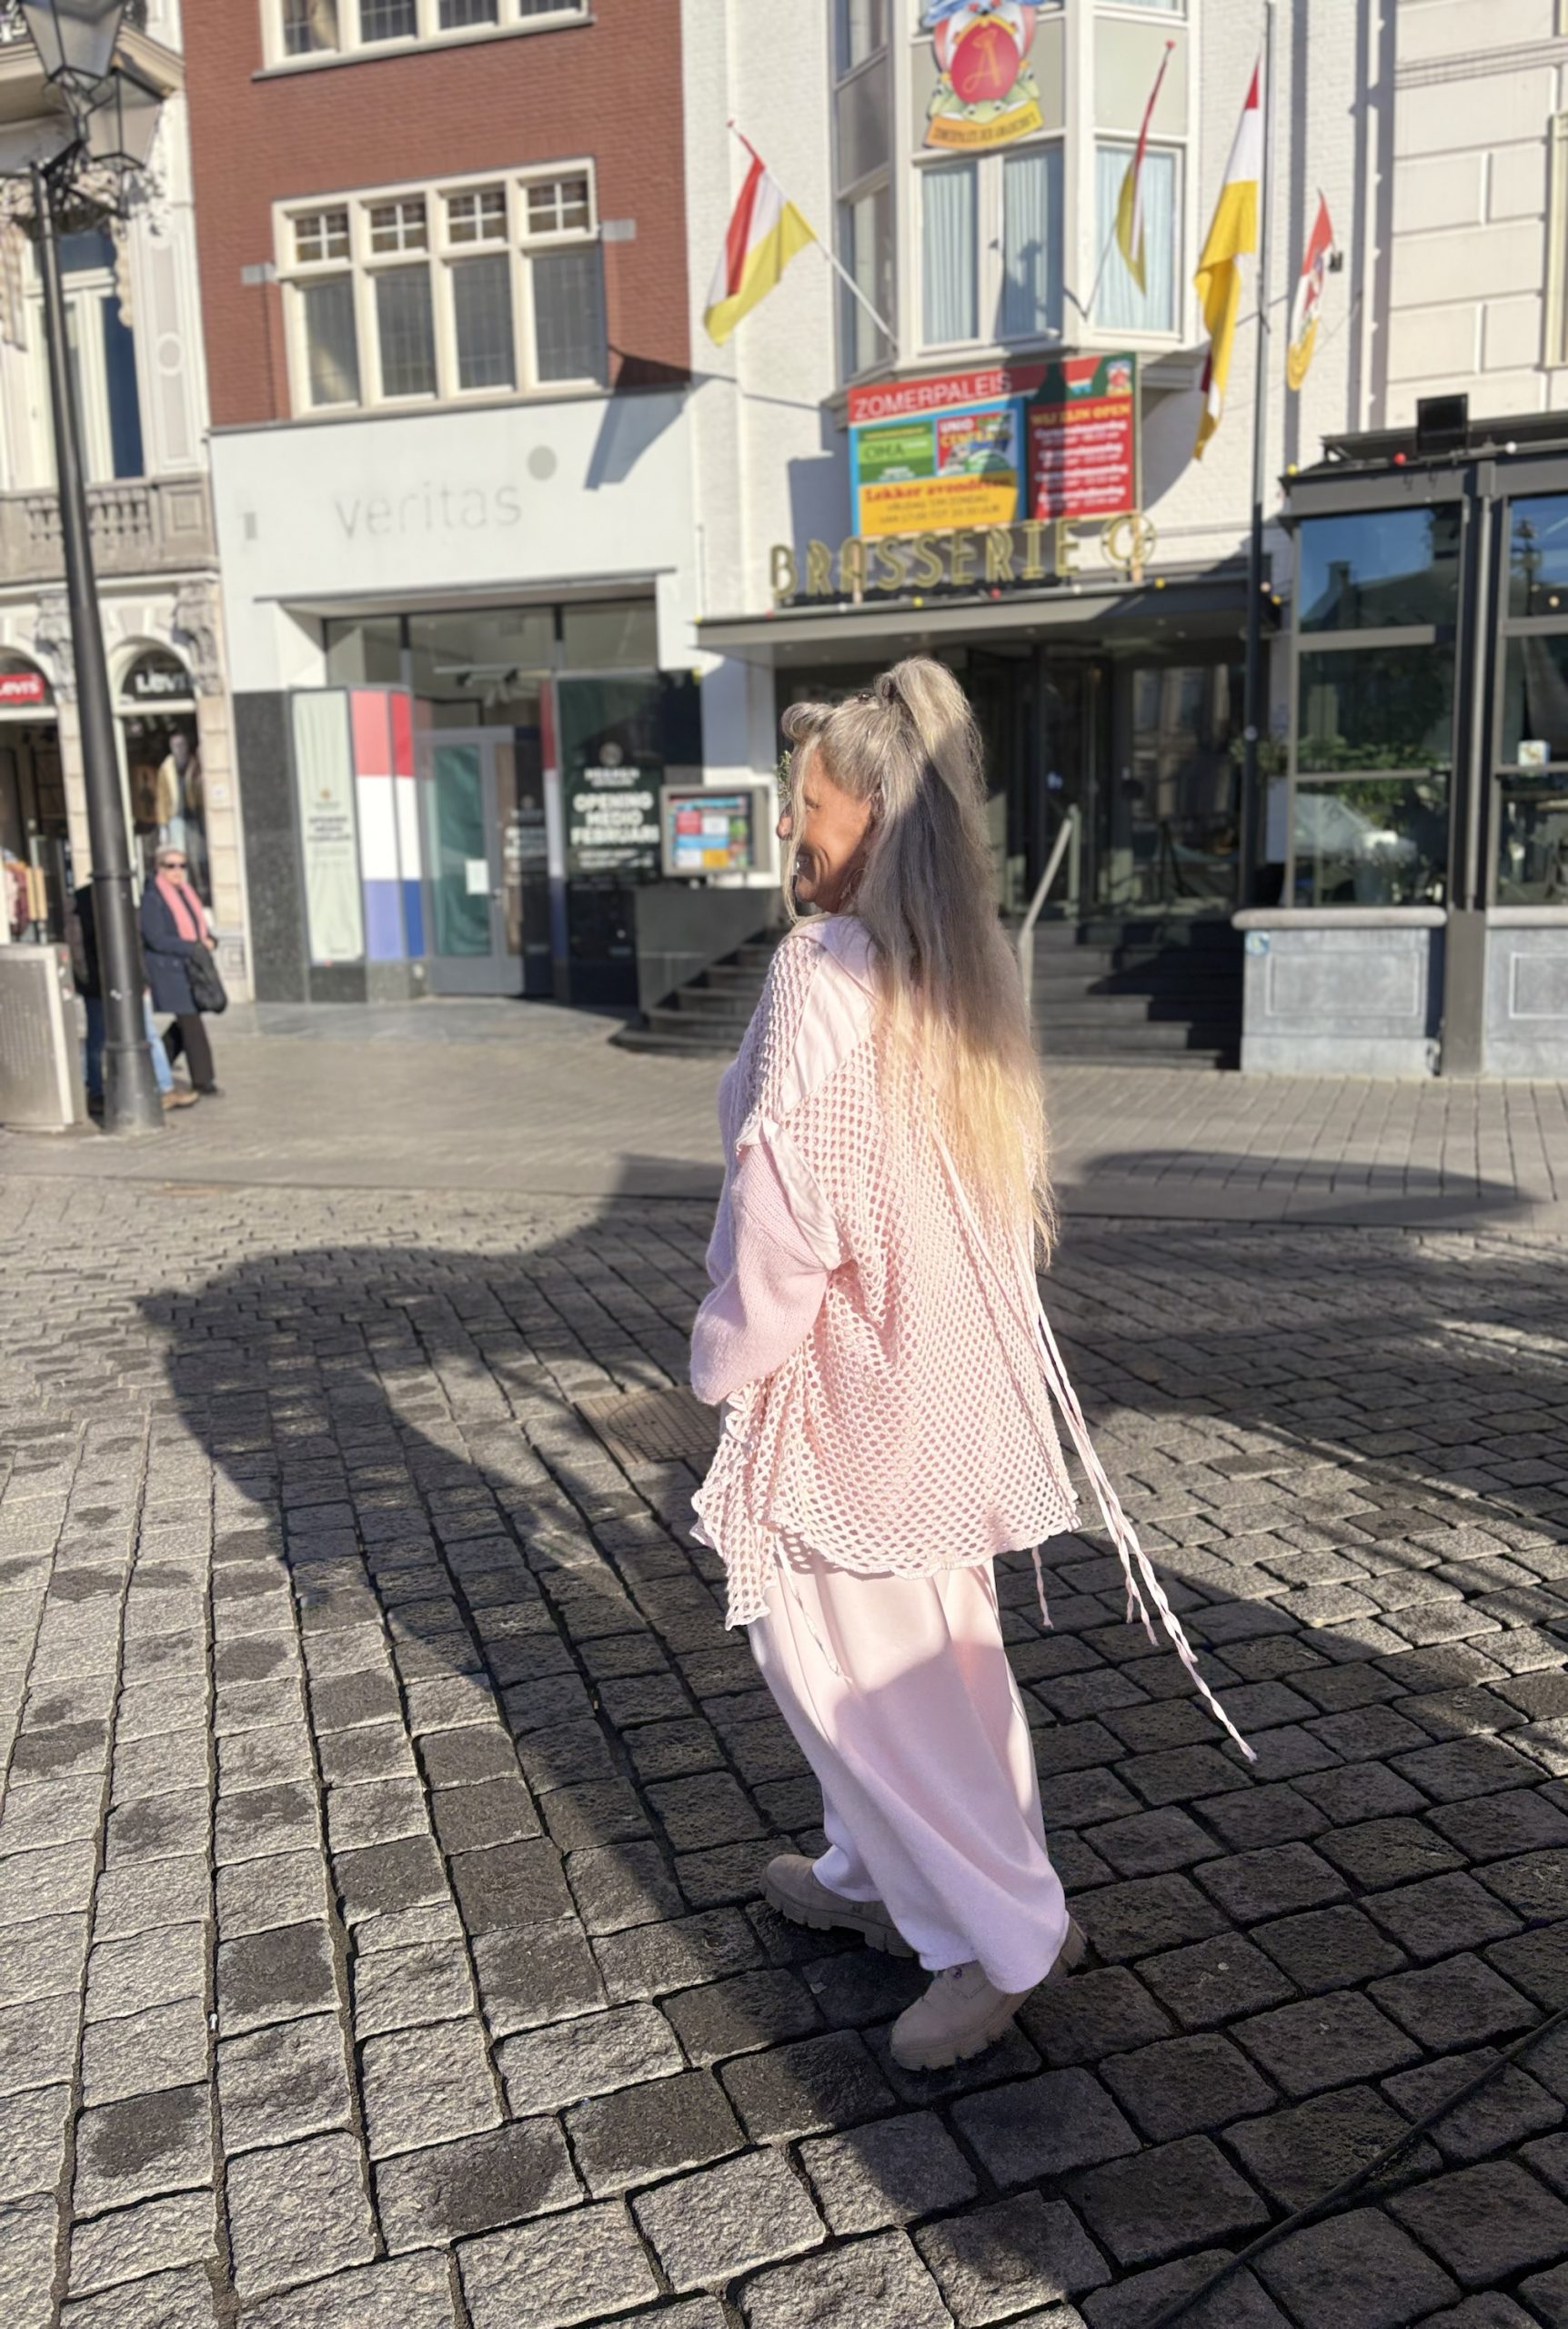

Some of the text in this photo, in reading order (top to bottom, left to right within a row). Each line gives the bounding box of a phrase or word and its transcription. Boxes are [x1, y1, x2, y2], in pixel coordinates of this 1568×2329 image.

[853, 371, 1013, 420] ZOMERPALEIS
[333, 480, 523, 539] veritas
[770, 518, 1081, 600] BRASSERIE
[573, 791, 654, 812] OPENING
[570, 824, 660, 846] FEBRUARI
